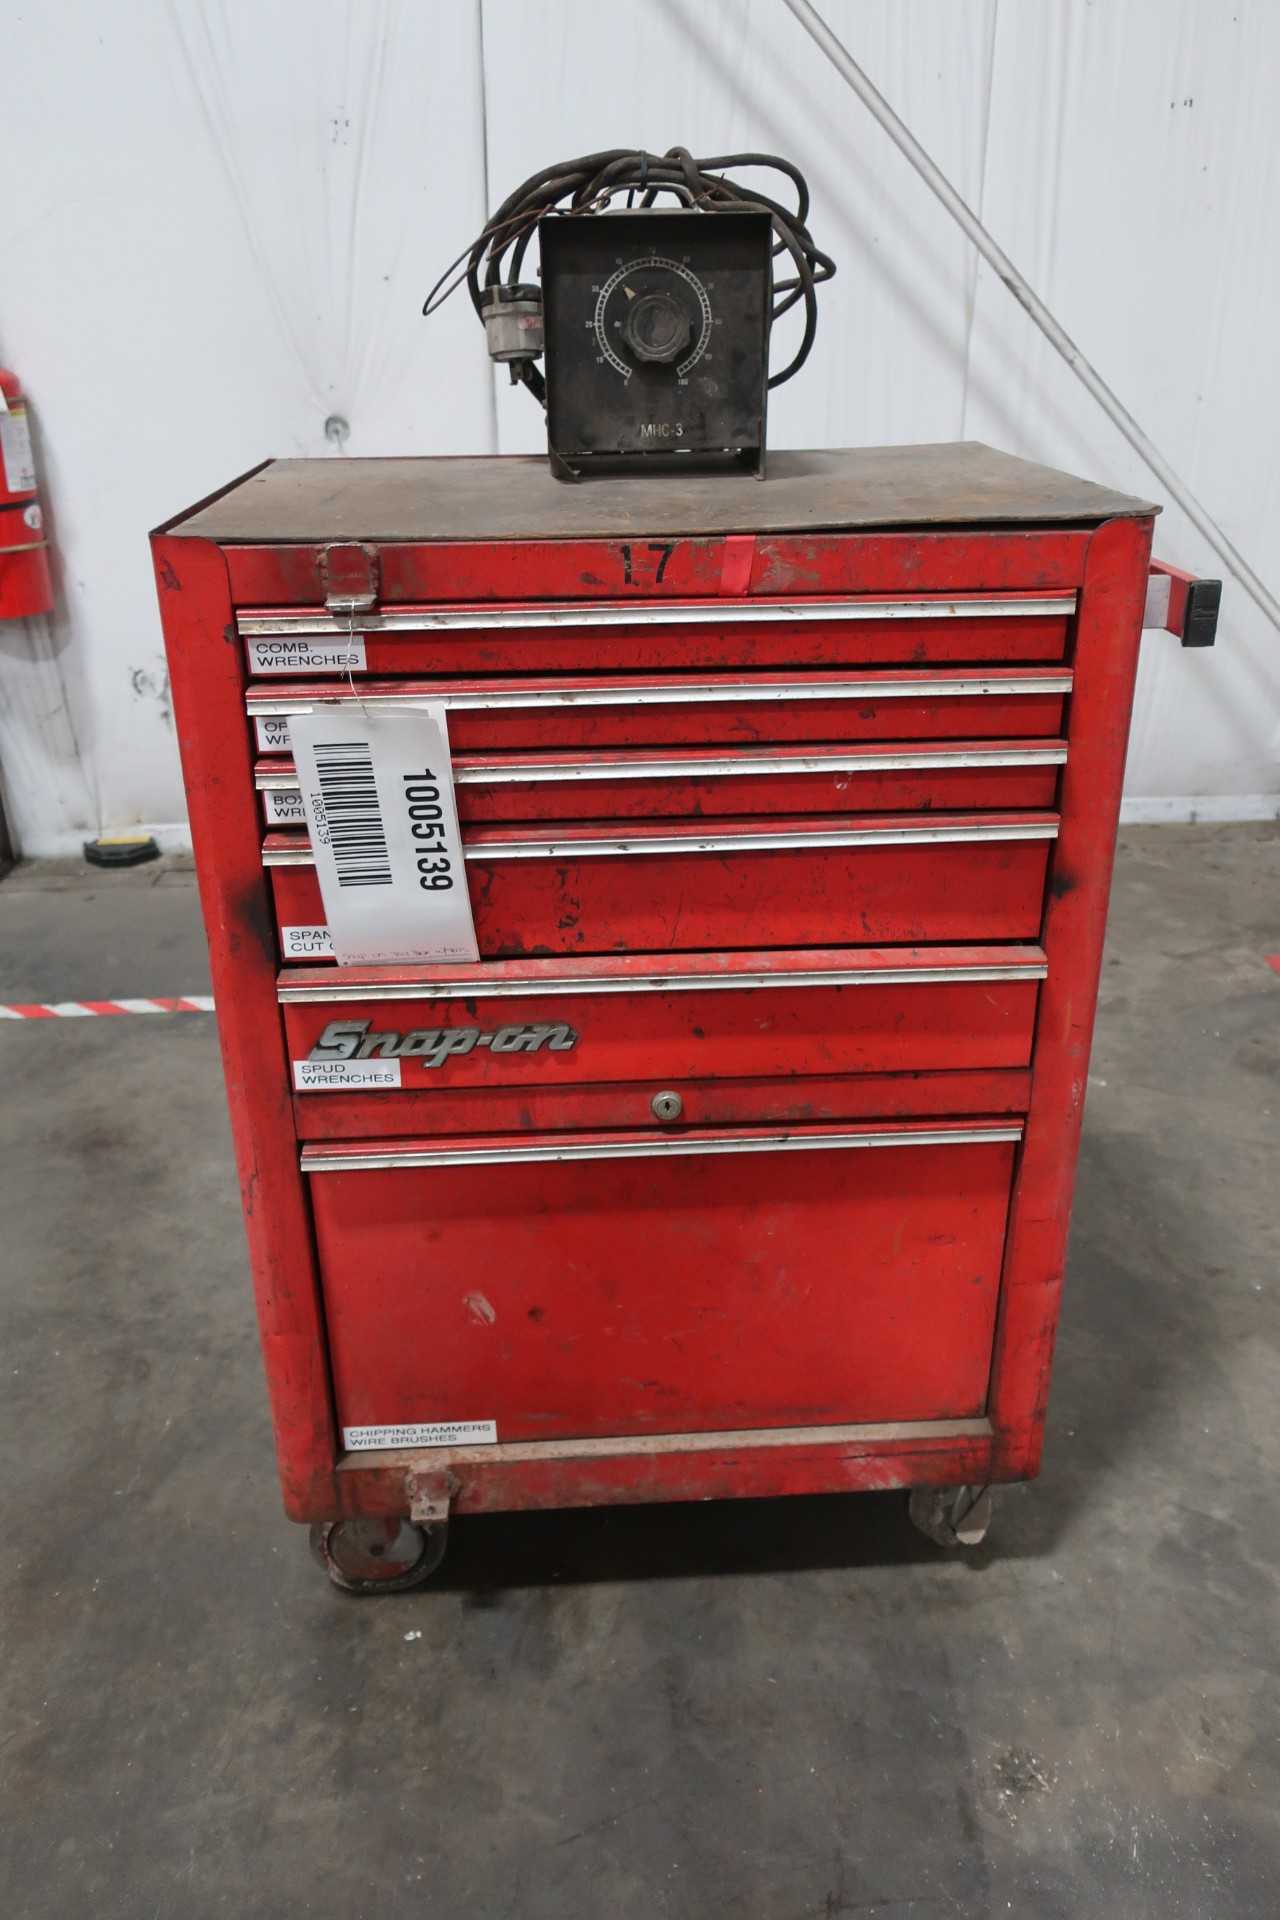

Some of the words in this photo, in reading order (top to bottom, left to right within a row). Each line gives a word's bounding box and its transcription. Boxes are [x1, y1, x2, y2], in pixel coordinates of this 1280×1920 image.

[256, 642, 314, 655] COMB.
[257, 654, 360, 667] WRENCHES
[310, 792, 332, 845] 1005139
[403, 767, 454, 891] 1005139
[290, 942, 324, 952] CUT
[305, 1019, 578, 1069] Snap-on
[301, 1063, 346, 1075] SPUD
[302, 1073, 395, 1085] WRENCHES
[349, 1427, 417, 1438] CHIPPING
[420, 1424, 491, 1434] HAMMERS
[350, 1437, 386, 1447] WIRE
[390, 1434, 457, 1445] BRUSHES
